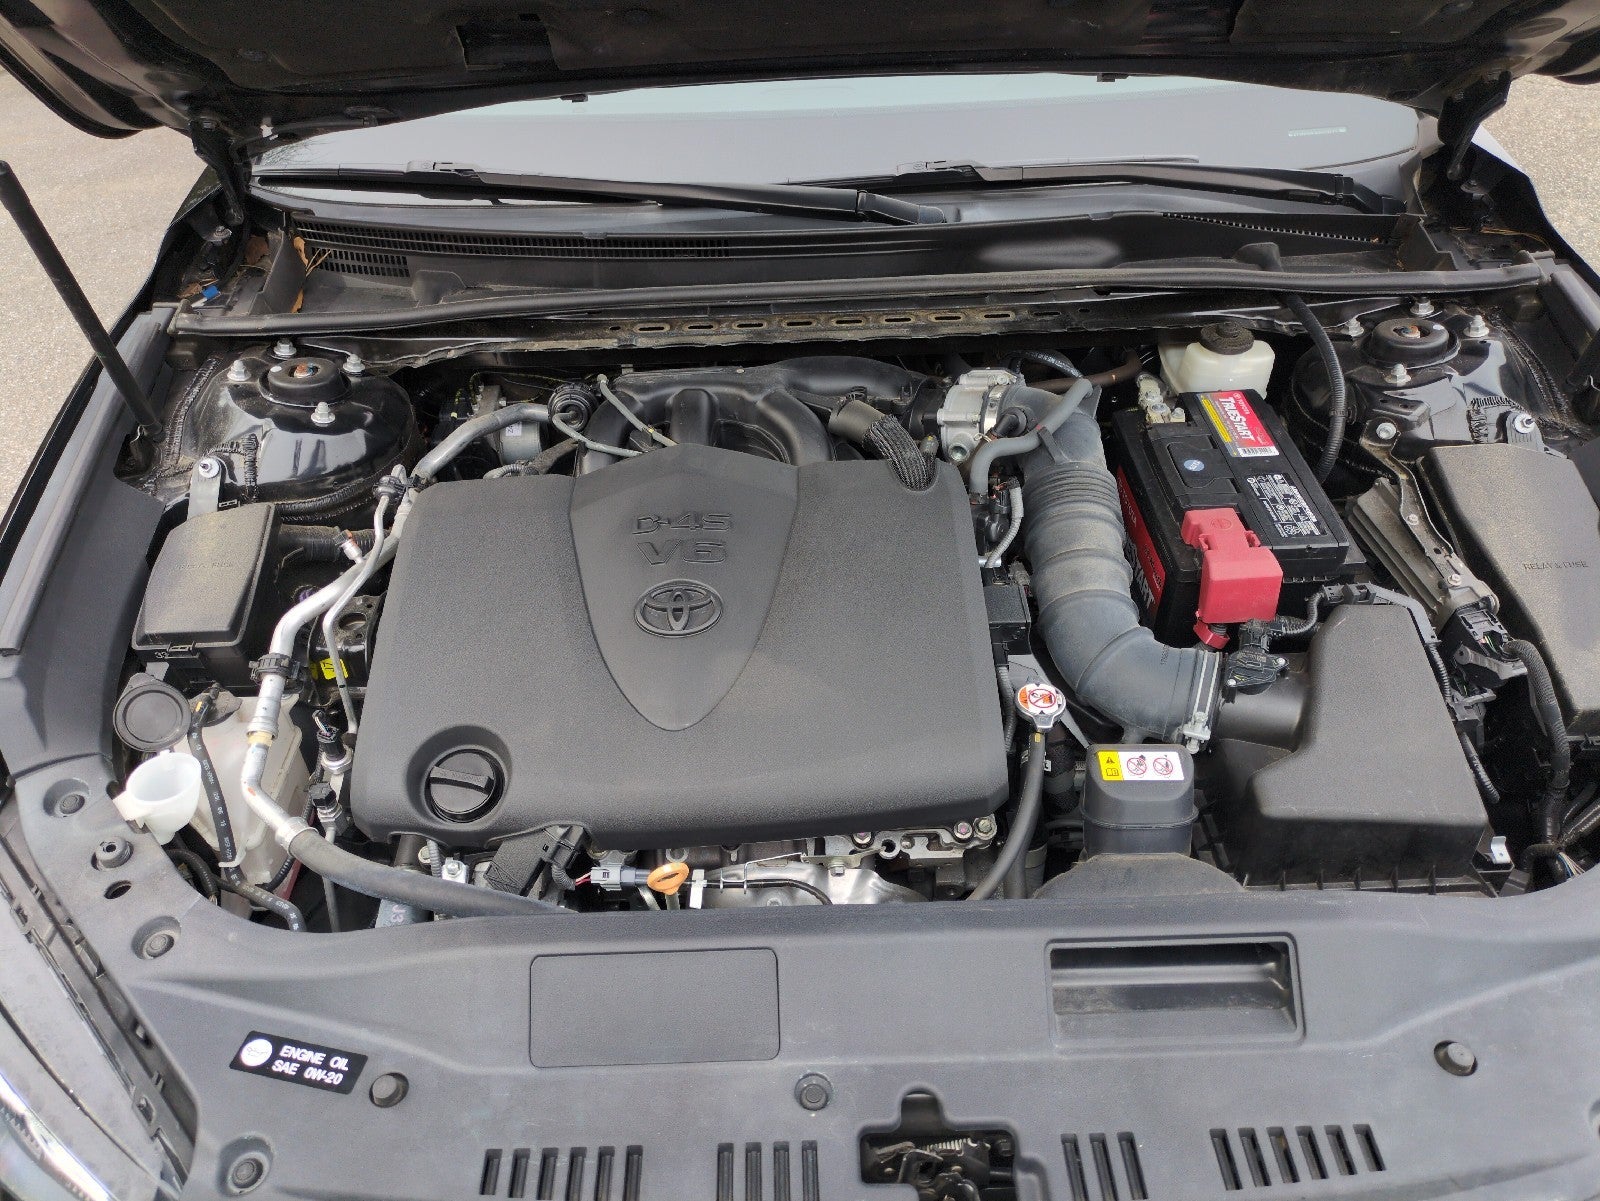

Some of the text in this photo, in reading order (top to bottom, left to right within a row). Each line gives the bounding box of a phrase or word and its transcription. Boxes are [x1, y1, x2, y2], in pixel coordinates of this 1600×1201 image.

[636, 539, 728, 566] V6
[279, 1044, 349, 1071] ENGINE OIL
[271, 1059, 344, 1085] SAE 0W-20
